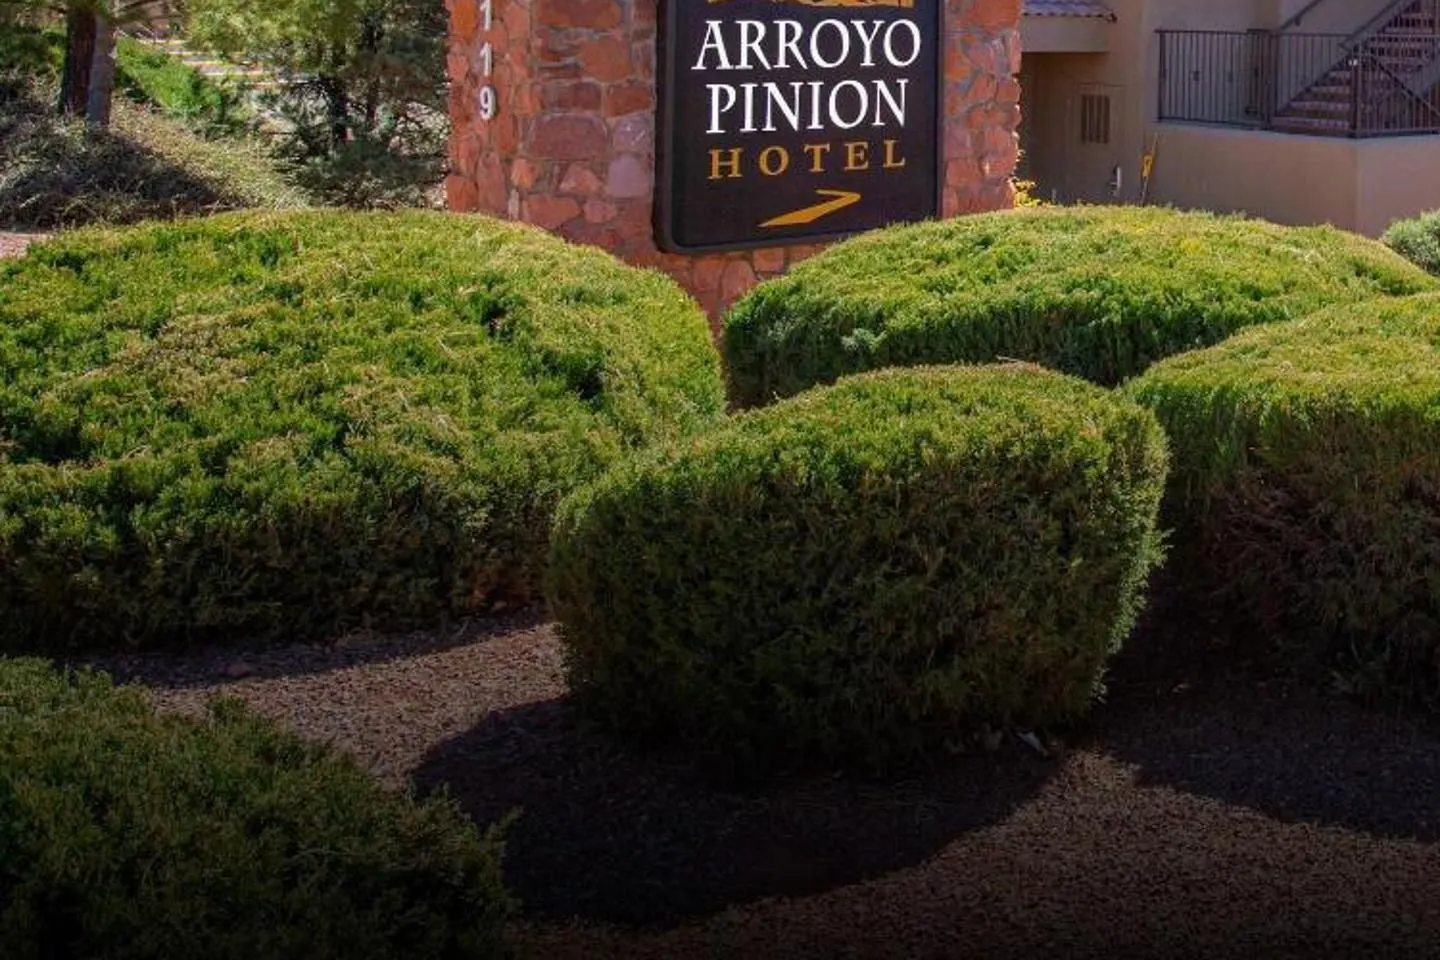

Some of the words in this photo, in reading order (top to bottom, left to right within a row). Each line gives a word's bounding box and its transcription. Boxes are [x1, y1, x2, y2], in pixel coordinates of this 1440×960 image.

[691, 18, 922, 71] ARROYO
[705, 78, 907, 134] PINION
[708, 139, 906, 179] HOTEL
